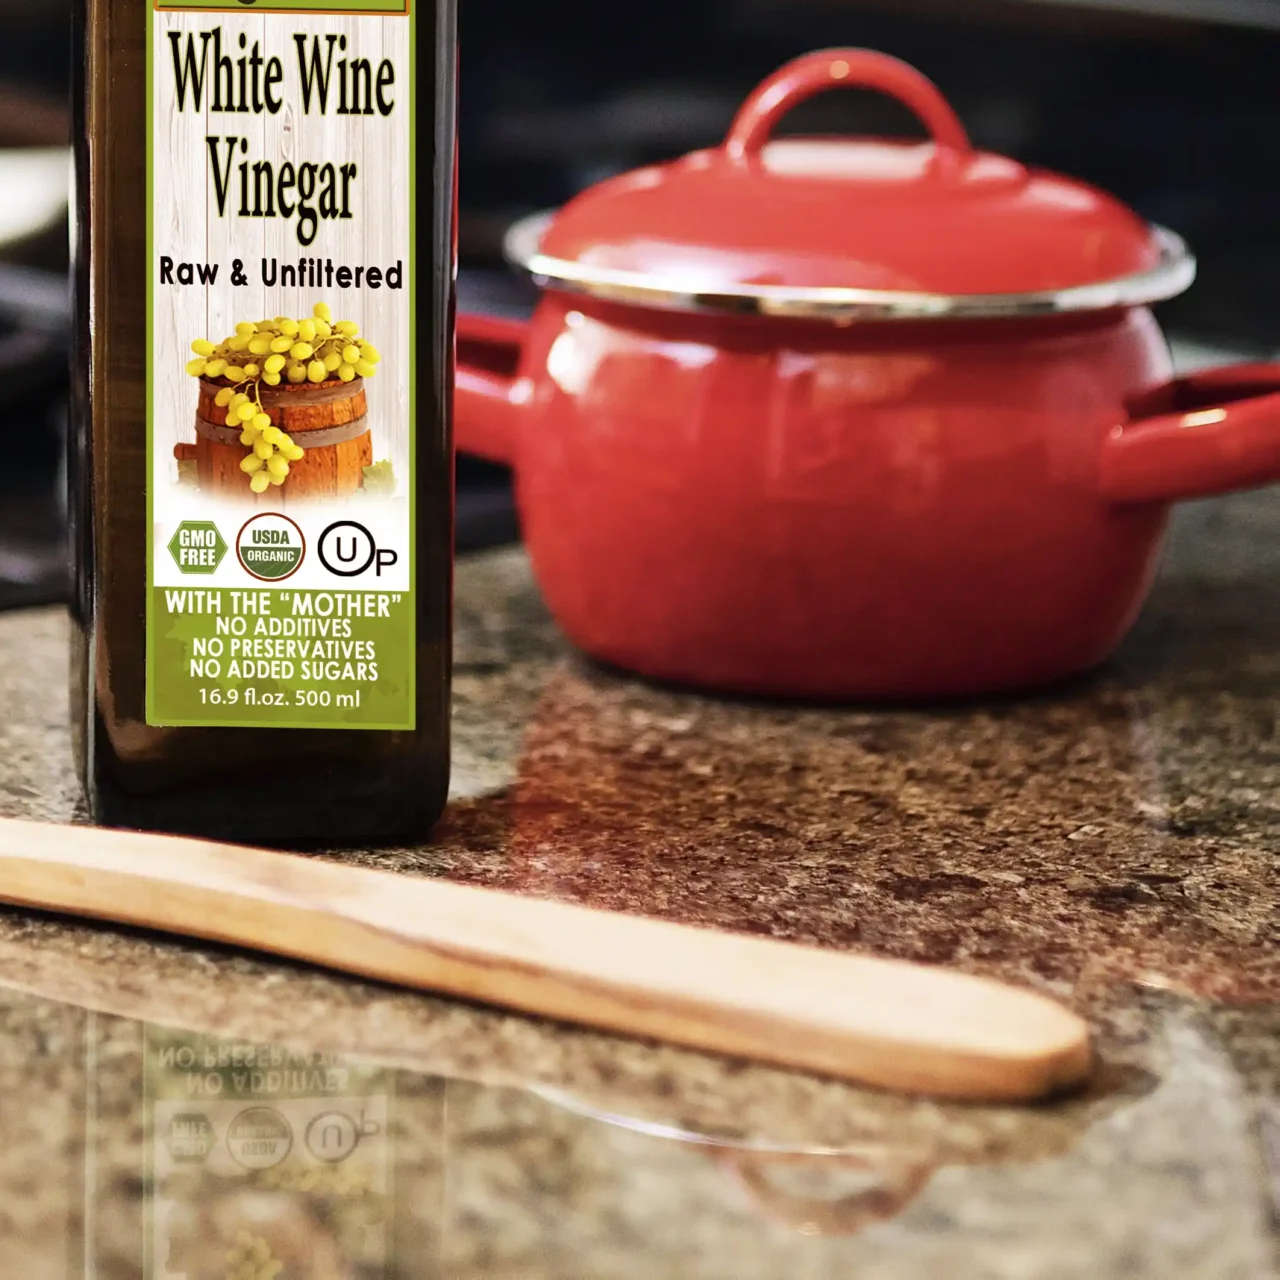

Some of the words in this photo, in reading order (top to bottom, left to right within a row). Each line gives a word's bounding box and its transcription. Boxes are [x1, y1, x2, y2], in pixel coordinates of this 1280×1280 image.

[167, 26, 283, 115] White
[293, 33, 395, 117] Wine
[205, 135, 357, 247] Vinegar
[160, 255, 219, 286] Raw
[230, 258, 249, 287] &
[261, 257, 403, 290] Unfiltered
[179, 529, 216, 548] GMO
[252, 529, 290, 545] USDA
[179, 548, 216, 567] FREE
[247, 550, 295, 562] ORGANIC
[165, 590, 221, 614] WITH
[230, 591, 271, 615] THE
[216, 616, 247, 636] NO
[253, 617, 352, 638] ADDITIVES
[193, 637, 224, 657] NO
[230, 638, 376, 660] PRESERVATIVES
[190, 658, 221, 678] NO
[227, 659, 295, 679] ADDED
[301, 660, 379, 682] SUGARS
[199, 688, 239, 705] 16.9
[244, 687, 290, 706] fl.oz.
[295, 690, 331, 707] 500
[336, 689, 360, 708] ml
